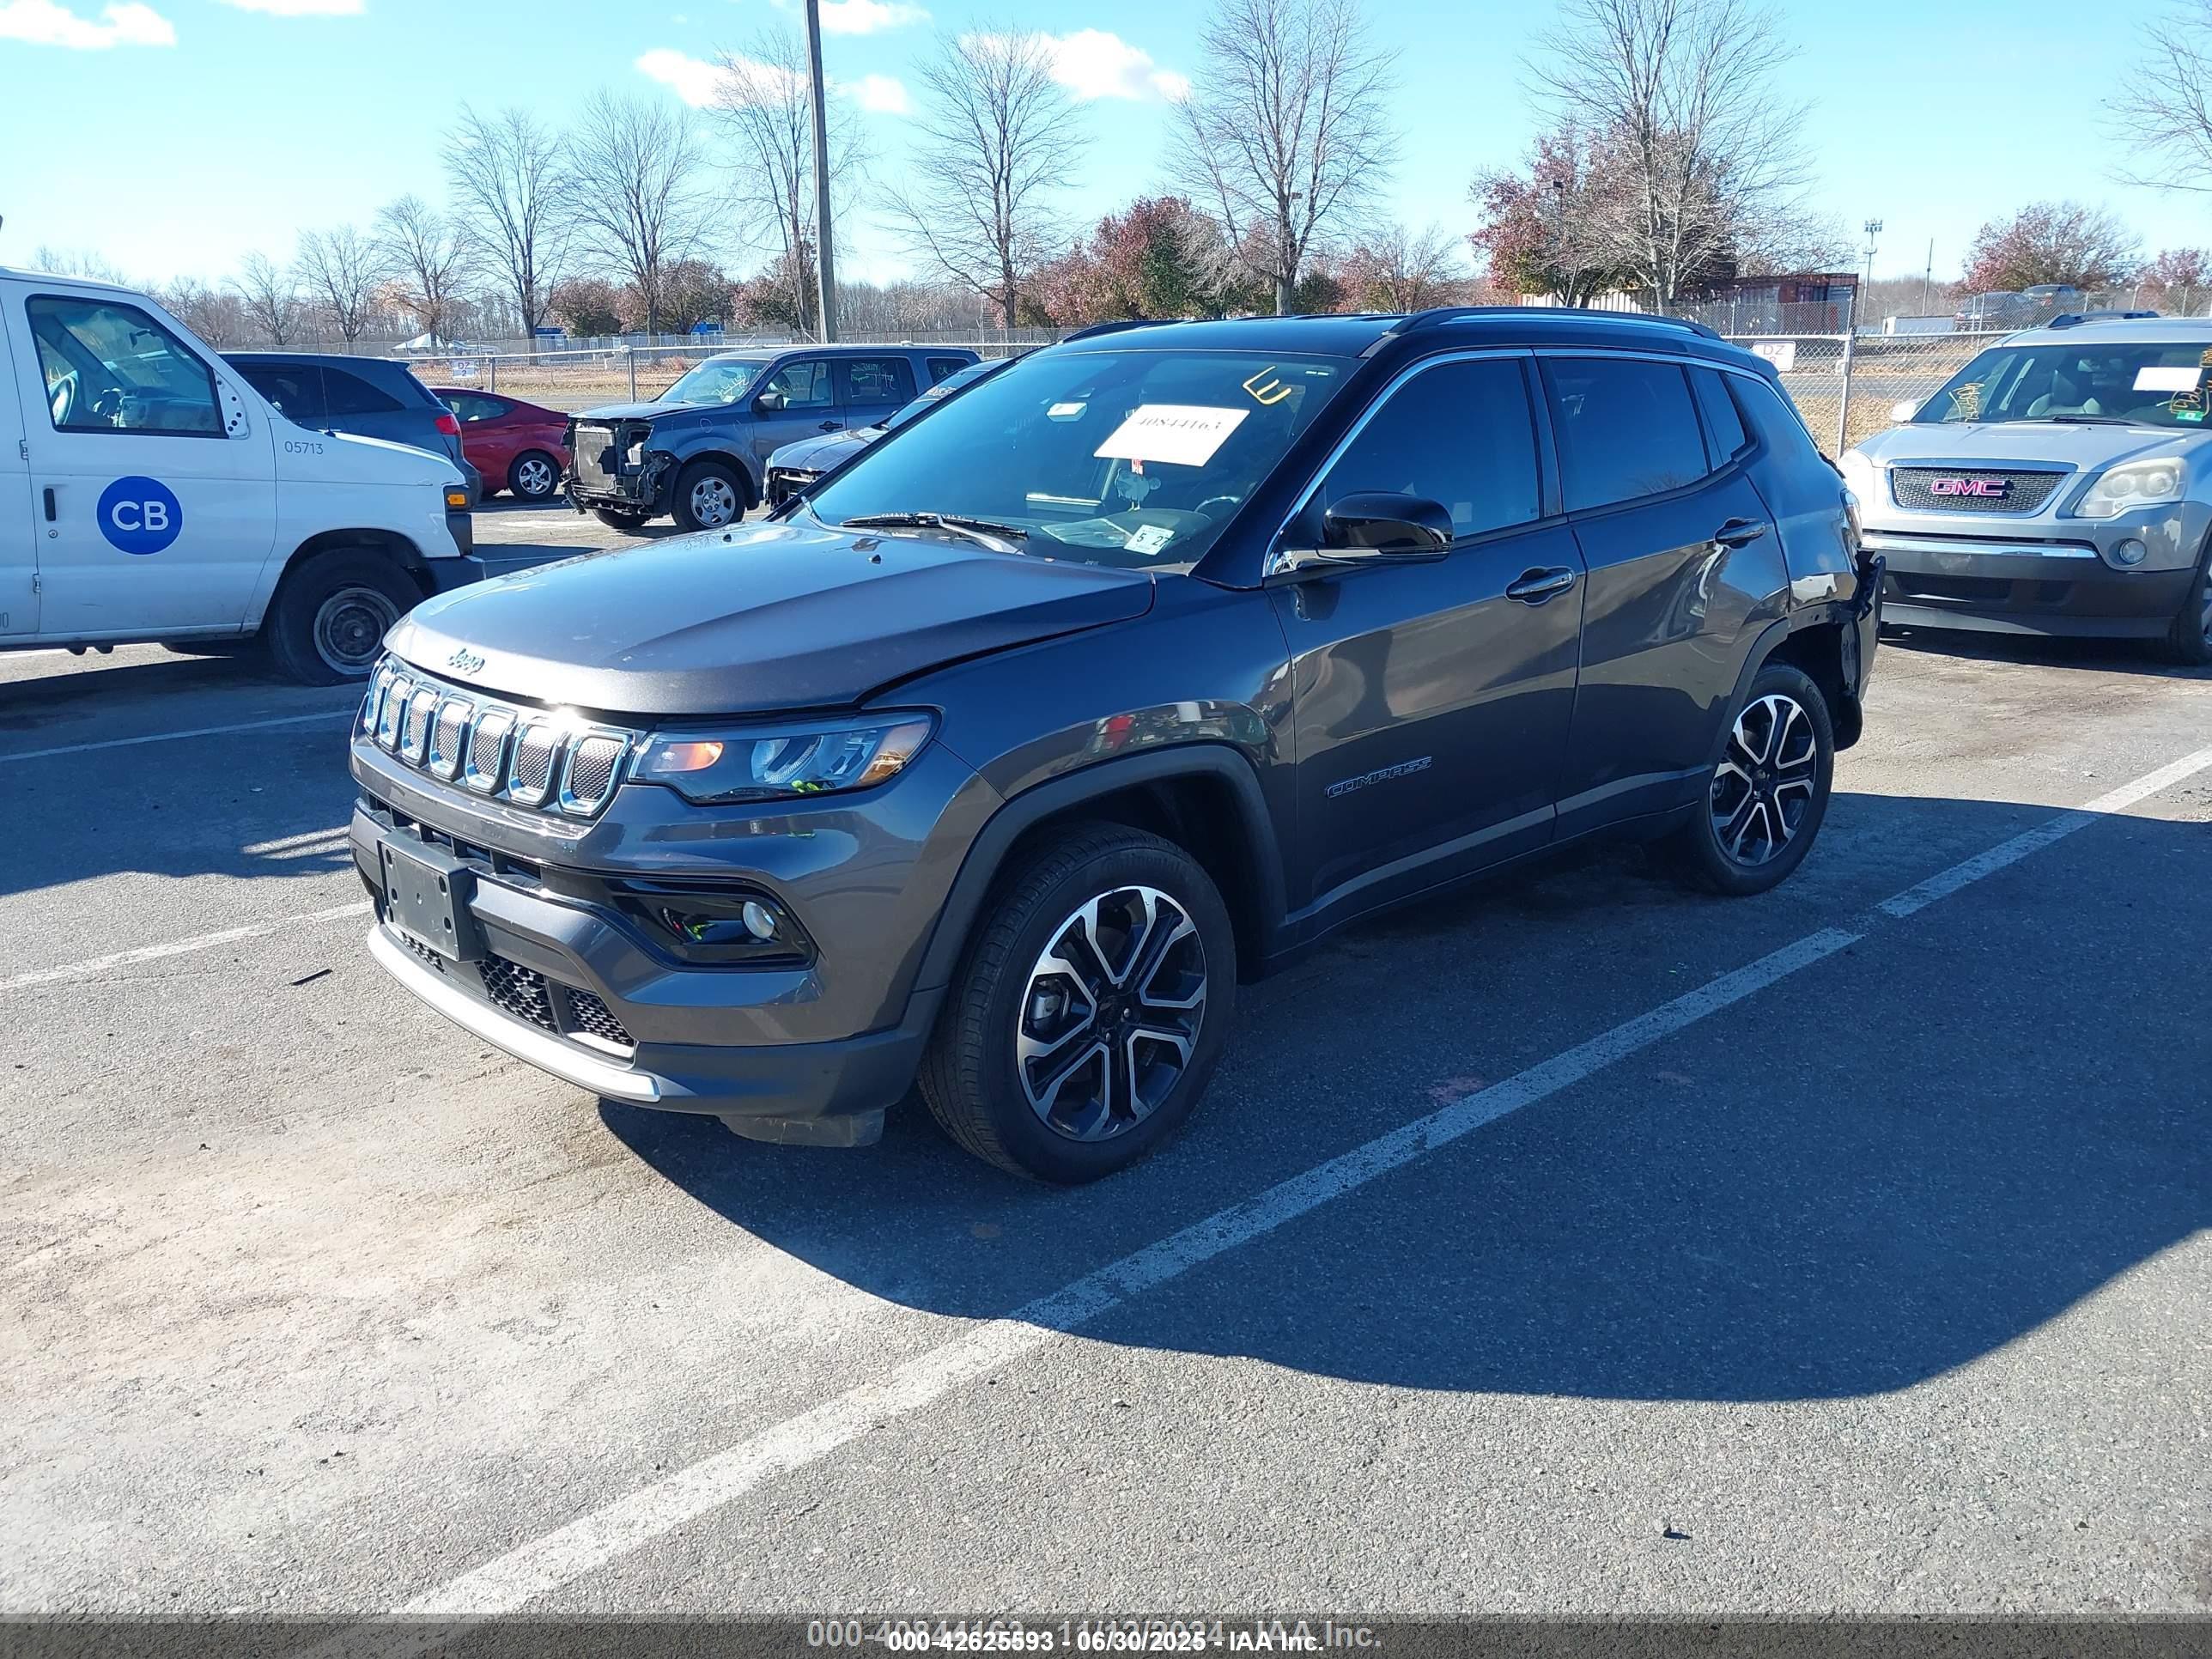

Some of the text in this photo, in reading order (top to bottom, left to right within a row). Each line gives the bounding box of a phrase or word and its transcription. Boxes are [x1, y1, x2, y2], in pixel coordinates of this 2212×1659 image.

[1763, 344, 1785, 355] DZ
[1243, 366, 1291, 404] E
[284, 441, 324, 454] 05713
[1930, 478, 2006, 496] GMC
[112, 501, 169, 531] CB
[1137, 532, 1147, 542] 5
[447, 647, 485, 676] Jeep
[1325, 757, 1432, 798] COMPASS
